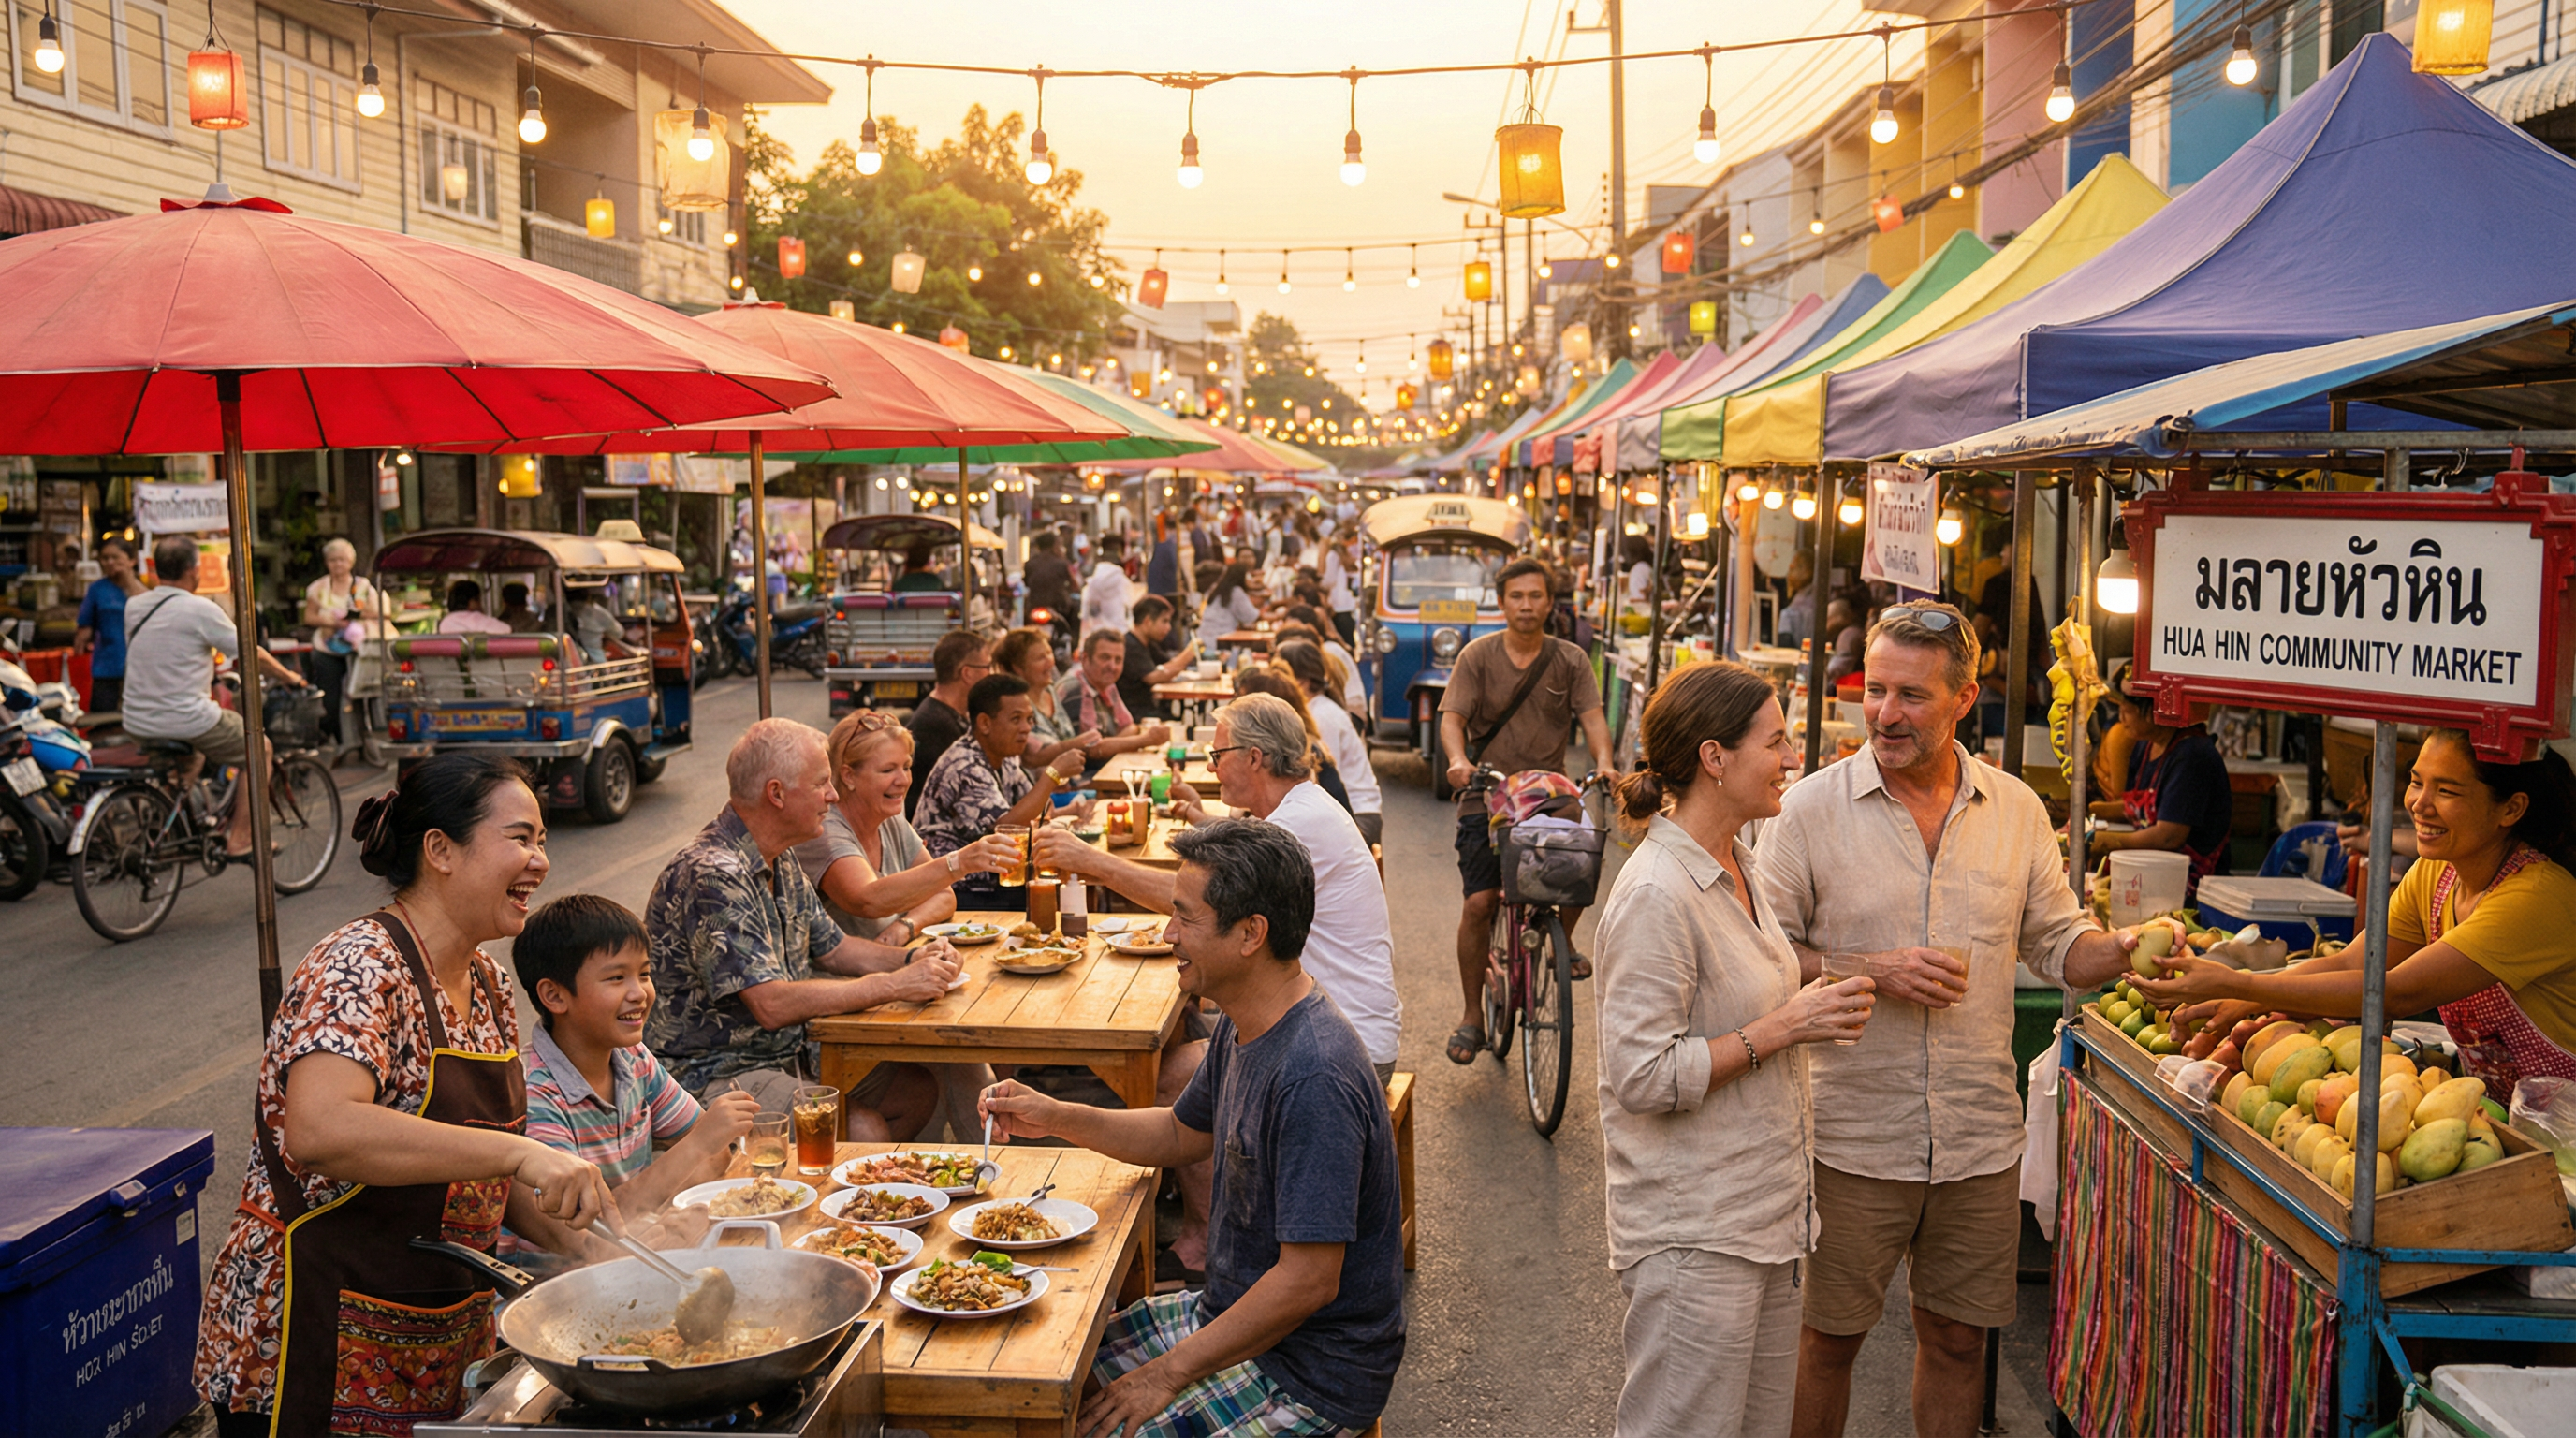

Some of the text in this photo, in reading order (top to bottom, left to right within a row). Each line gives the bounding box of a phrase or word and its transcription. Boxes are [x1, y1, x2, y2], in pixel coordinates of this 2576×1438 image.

[2195, 535, 2488, 627] มลายหัวหิน
[2163, 625, 2522, 685] HUA HIN COMMUNITY MARKET
